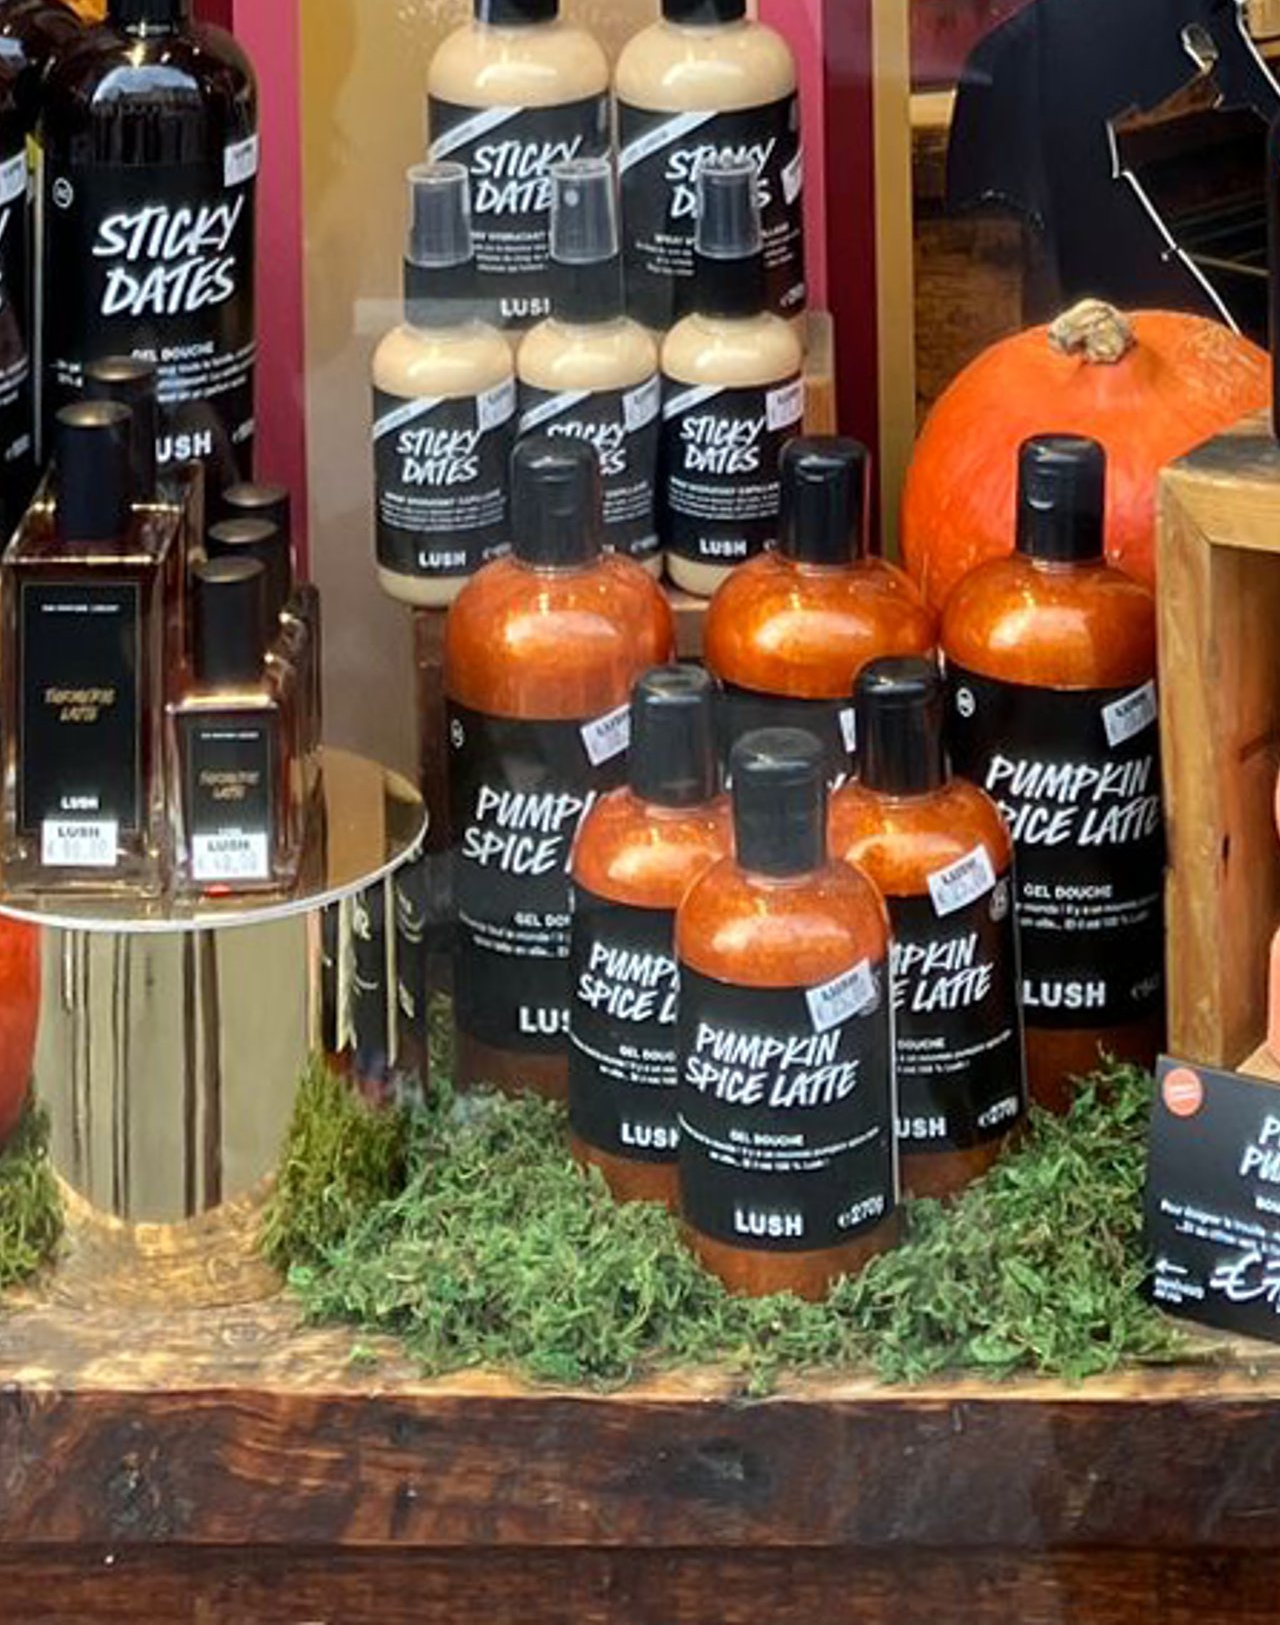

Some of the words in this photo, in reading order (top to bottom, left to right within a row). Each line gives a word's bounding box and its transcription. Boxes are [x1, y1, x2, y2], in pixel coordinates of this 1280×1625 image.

[470, 135, 583, 178] STICKY
[91, 193, 245, 261] STICKY
[100, 256, 237, 317] DATES
[397, 427, 482, 457] STICKY
[680, 415, 767, 447] STICKY
[402, 455, 479, 486] DATES
[684, 444, 759, 474] DATES
[419, 551, 466, 567] LUSH
[699, 539, 748, 556] LUSH
[985, 754, 1153, 804] PUMPKIN
[57, 825, 100, 838] LUSH
[1078, 795, 1161, 846] LATTE
[207, 838, 250, 852] LUSH
[463, 827, 562, 873] SPICE
[1023, 883, 1051, 899] GEL
[1054, 884, 1113, 901] DOUCHE
[577, 975, 656, 1023] SPICE
[914, 963, 992, 1012] LATTE
[1022, 979, 1106, 1009] LUSH
[696, 1022, 841, 1072] PUMPKIN
[684, 1057, 762, 1104] SPICE
[768, 1058, 860, 1108] LATTE
[734, 1207, 804, 1237] LUSH
